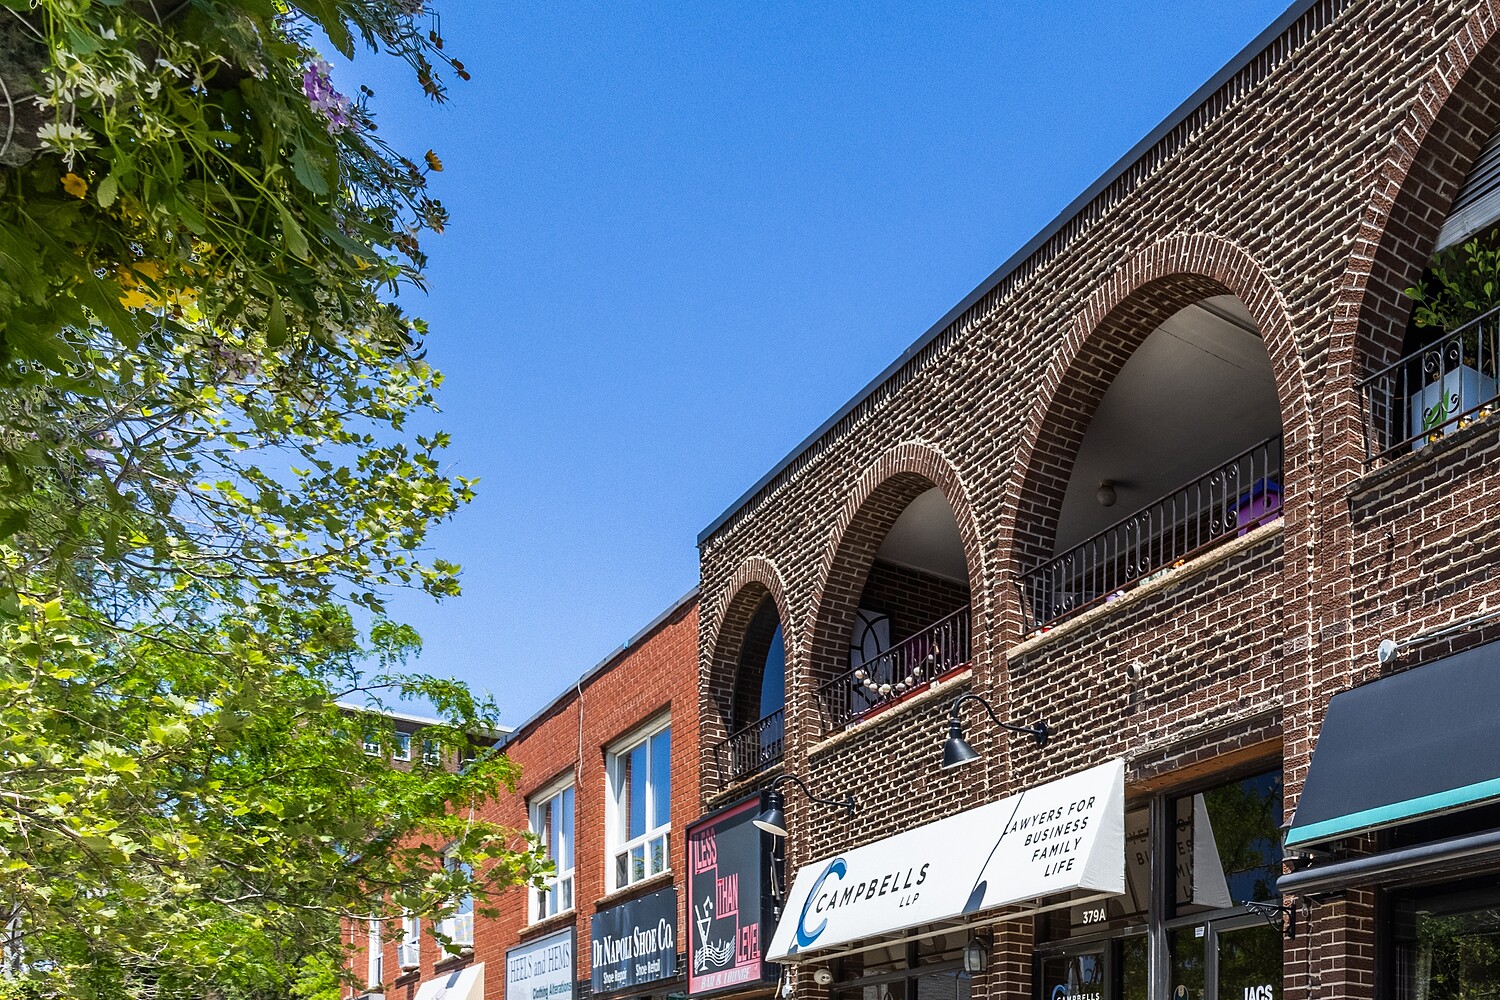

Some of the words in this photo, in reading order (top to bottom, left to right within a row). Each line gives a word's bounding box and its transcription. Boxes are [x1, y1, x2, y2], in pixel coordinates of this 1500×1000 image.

[1003, 805, 1064, 836] LAWYERS
[1068, 796, 1096, 816] FOR
[1023, 816, 1089, 847] BUSINESS
[697, 827, 717, 870] LESS
[1031, 837, 1083, 863] FAMILY
[1044, 858, 1076, 878] LIFE
[718, 873, 738, 916] THAN
[815, 862, 930, 914] CAMPBELLS
[899, 892, 921, 908] LLP
[1082, 907, 1107, 924] 379A
[737, 923, 760, 962] LEVEL
[510, 955, 533, 984] HEELS
[533, 950, 546, 977] and
[548, 942, 570, 973] HEMS
[701, 975, 715, 990] BAR
[724, 967, 751, 984] LOUNGE
[533, 984, 548, 1000] Clothing
[549, 980, 572, 995] Alterations
